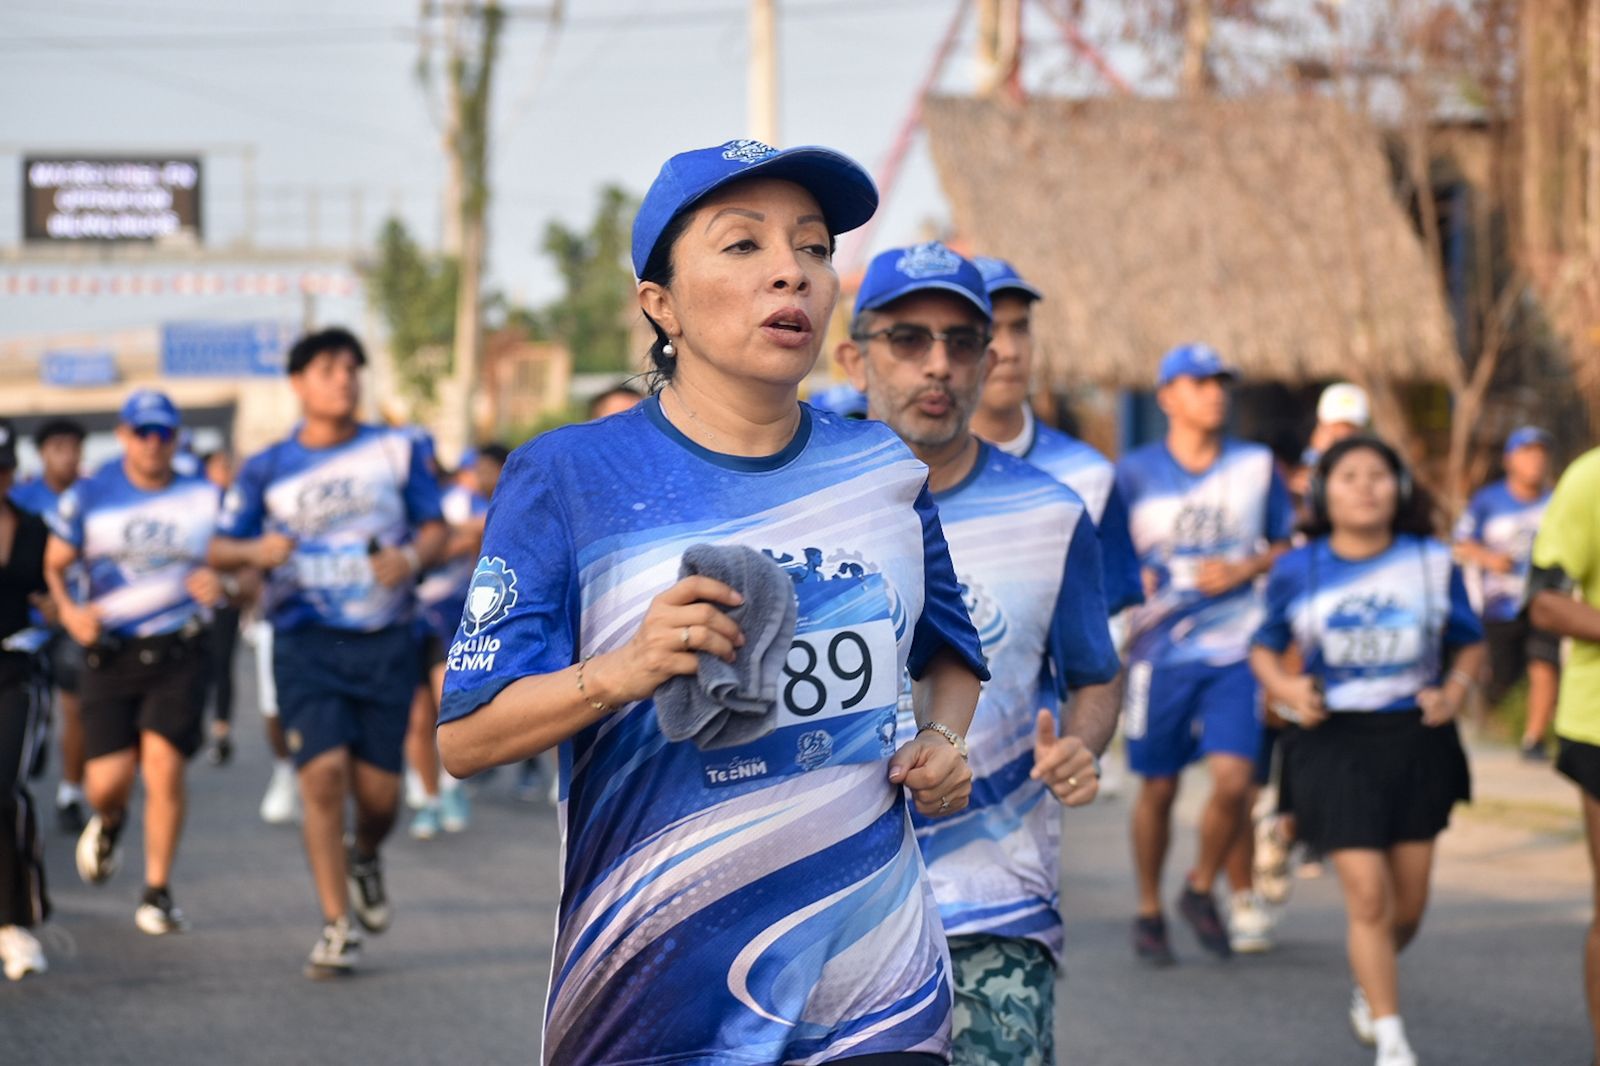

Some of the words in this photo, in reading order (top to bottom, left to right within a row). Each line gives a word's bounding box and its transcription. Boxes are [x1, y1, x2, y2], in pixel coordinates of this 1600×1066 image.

[449, 635, 501, 656] gullo
[1338, 630, 1401, 661] 287
[783, 631, 873, 717] 89
[706, 761, 767, 783] TecNM
